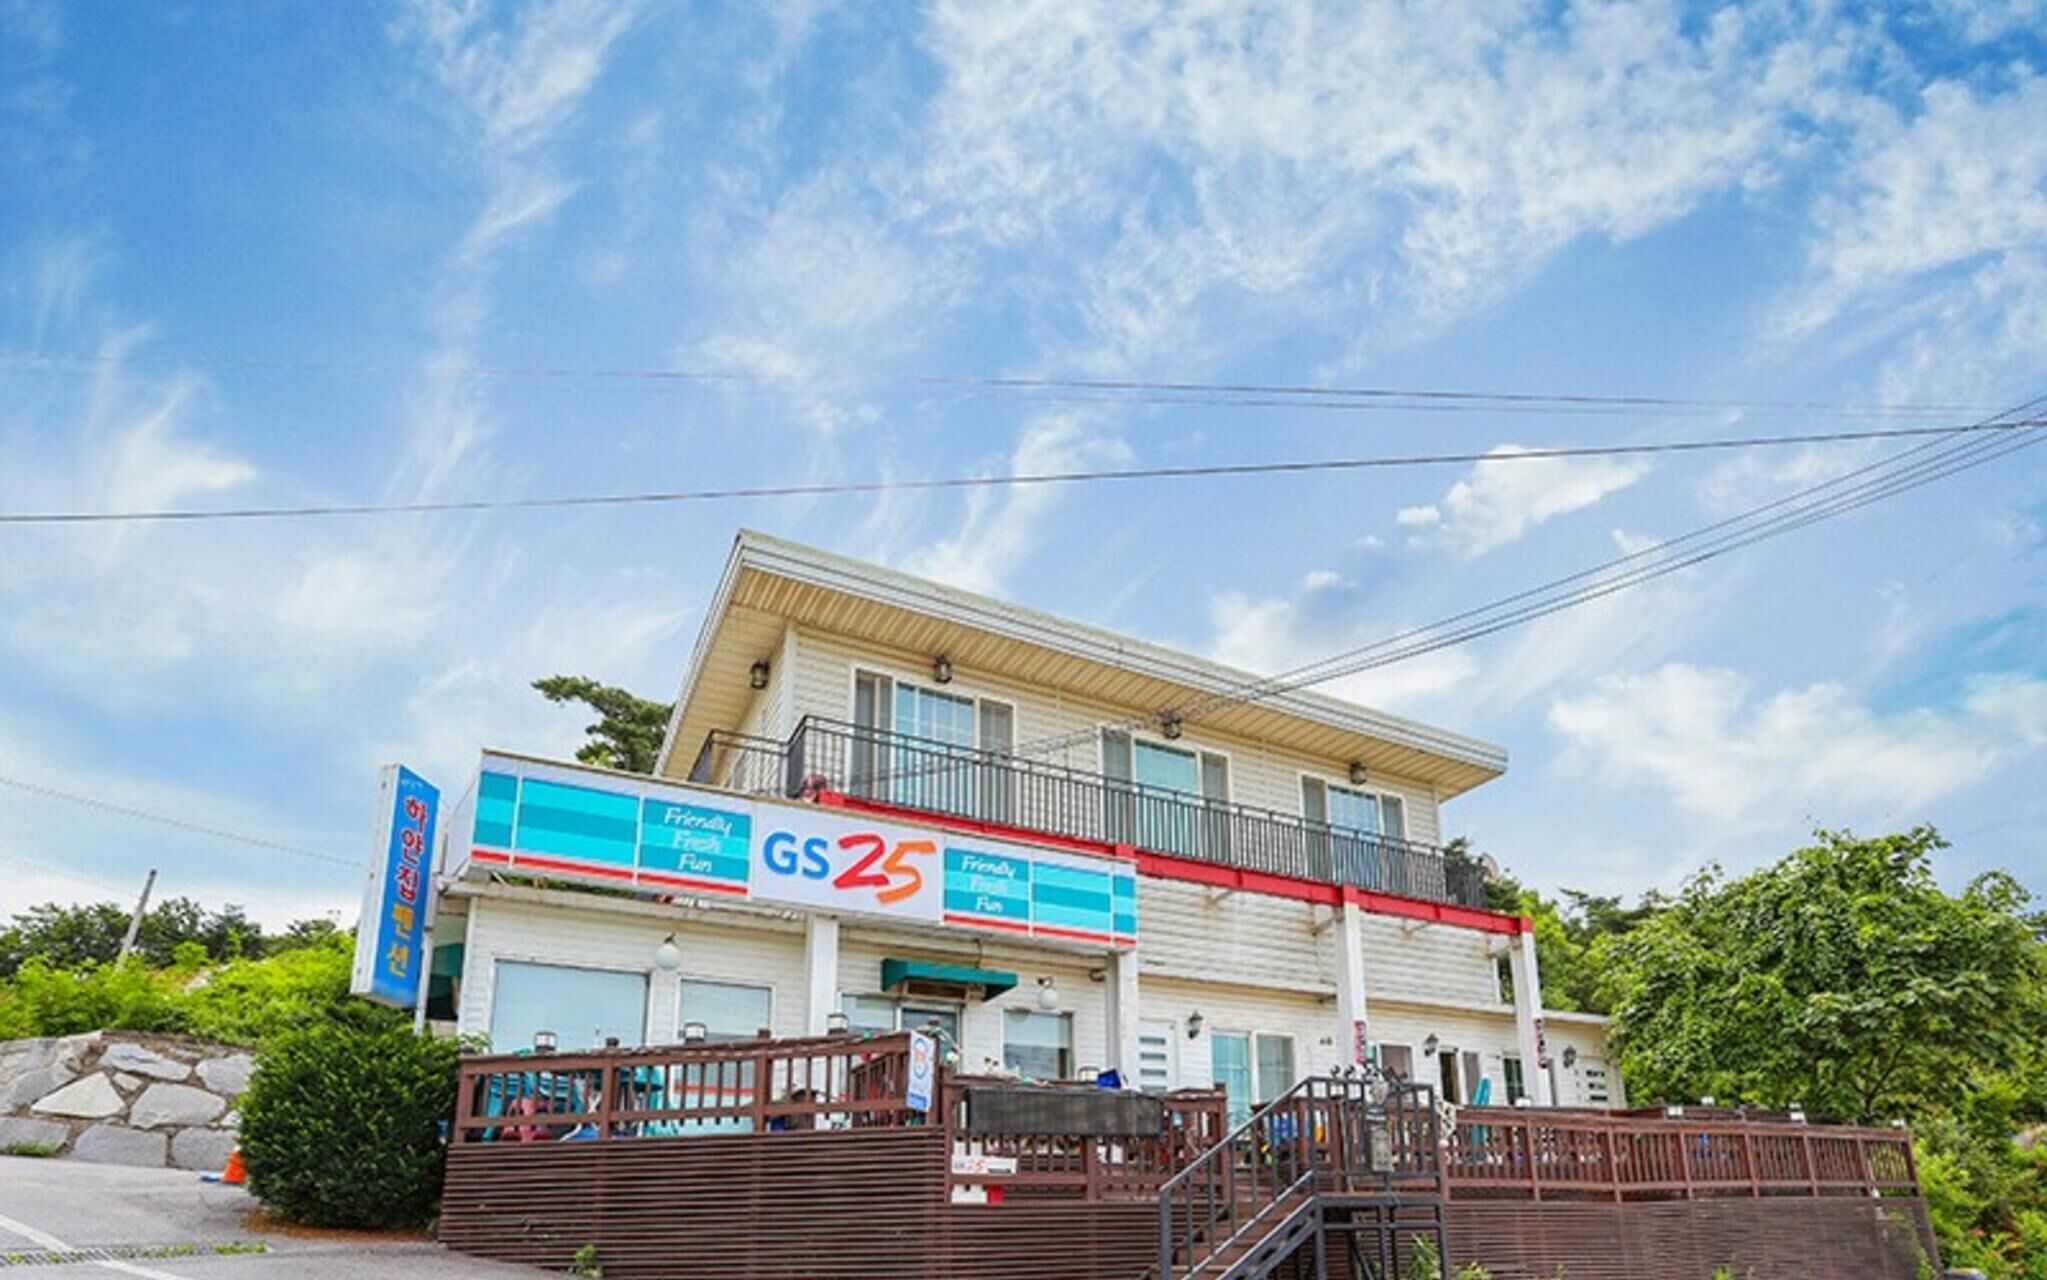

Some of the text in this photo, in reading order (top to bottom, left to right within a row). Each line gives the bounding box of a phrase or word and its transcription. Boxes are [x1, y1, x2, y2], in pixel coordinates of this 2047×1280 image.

[663, 807, 733, 838] Friendly
[677, 853, 713, 873] Fun
[763, 832, 936, 904] GS25
[961, 855, 1017, 879] Friendly
[975, 895, 1004, 914] Fun
